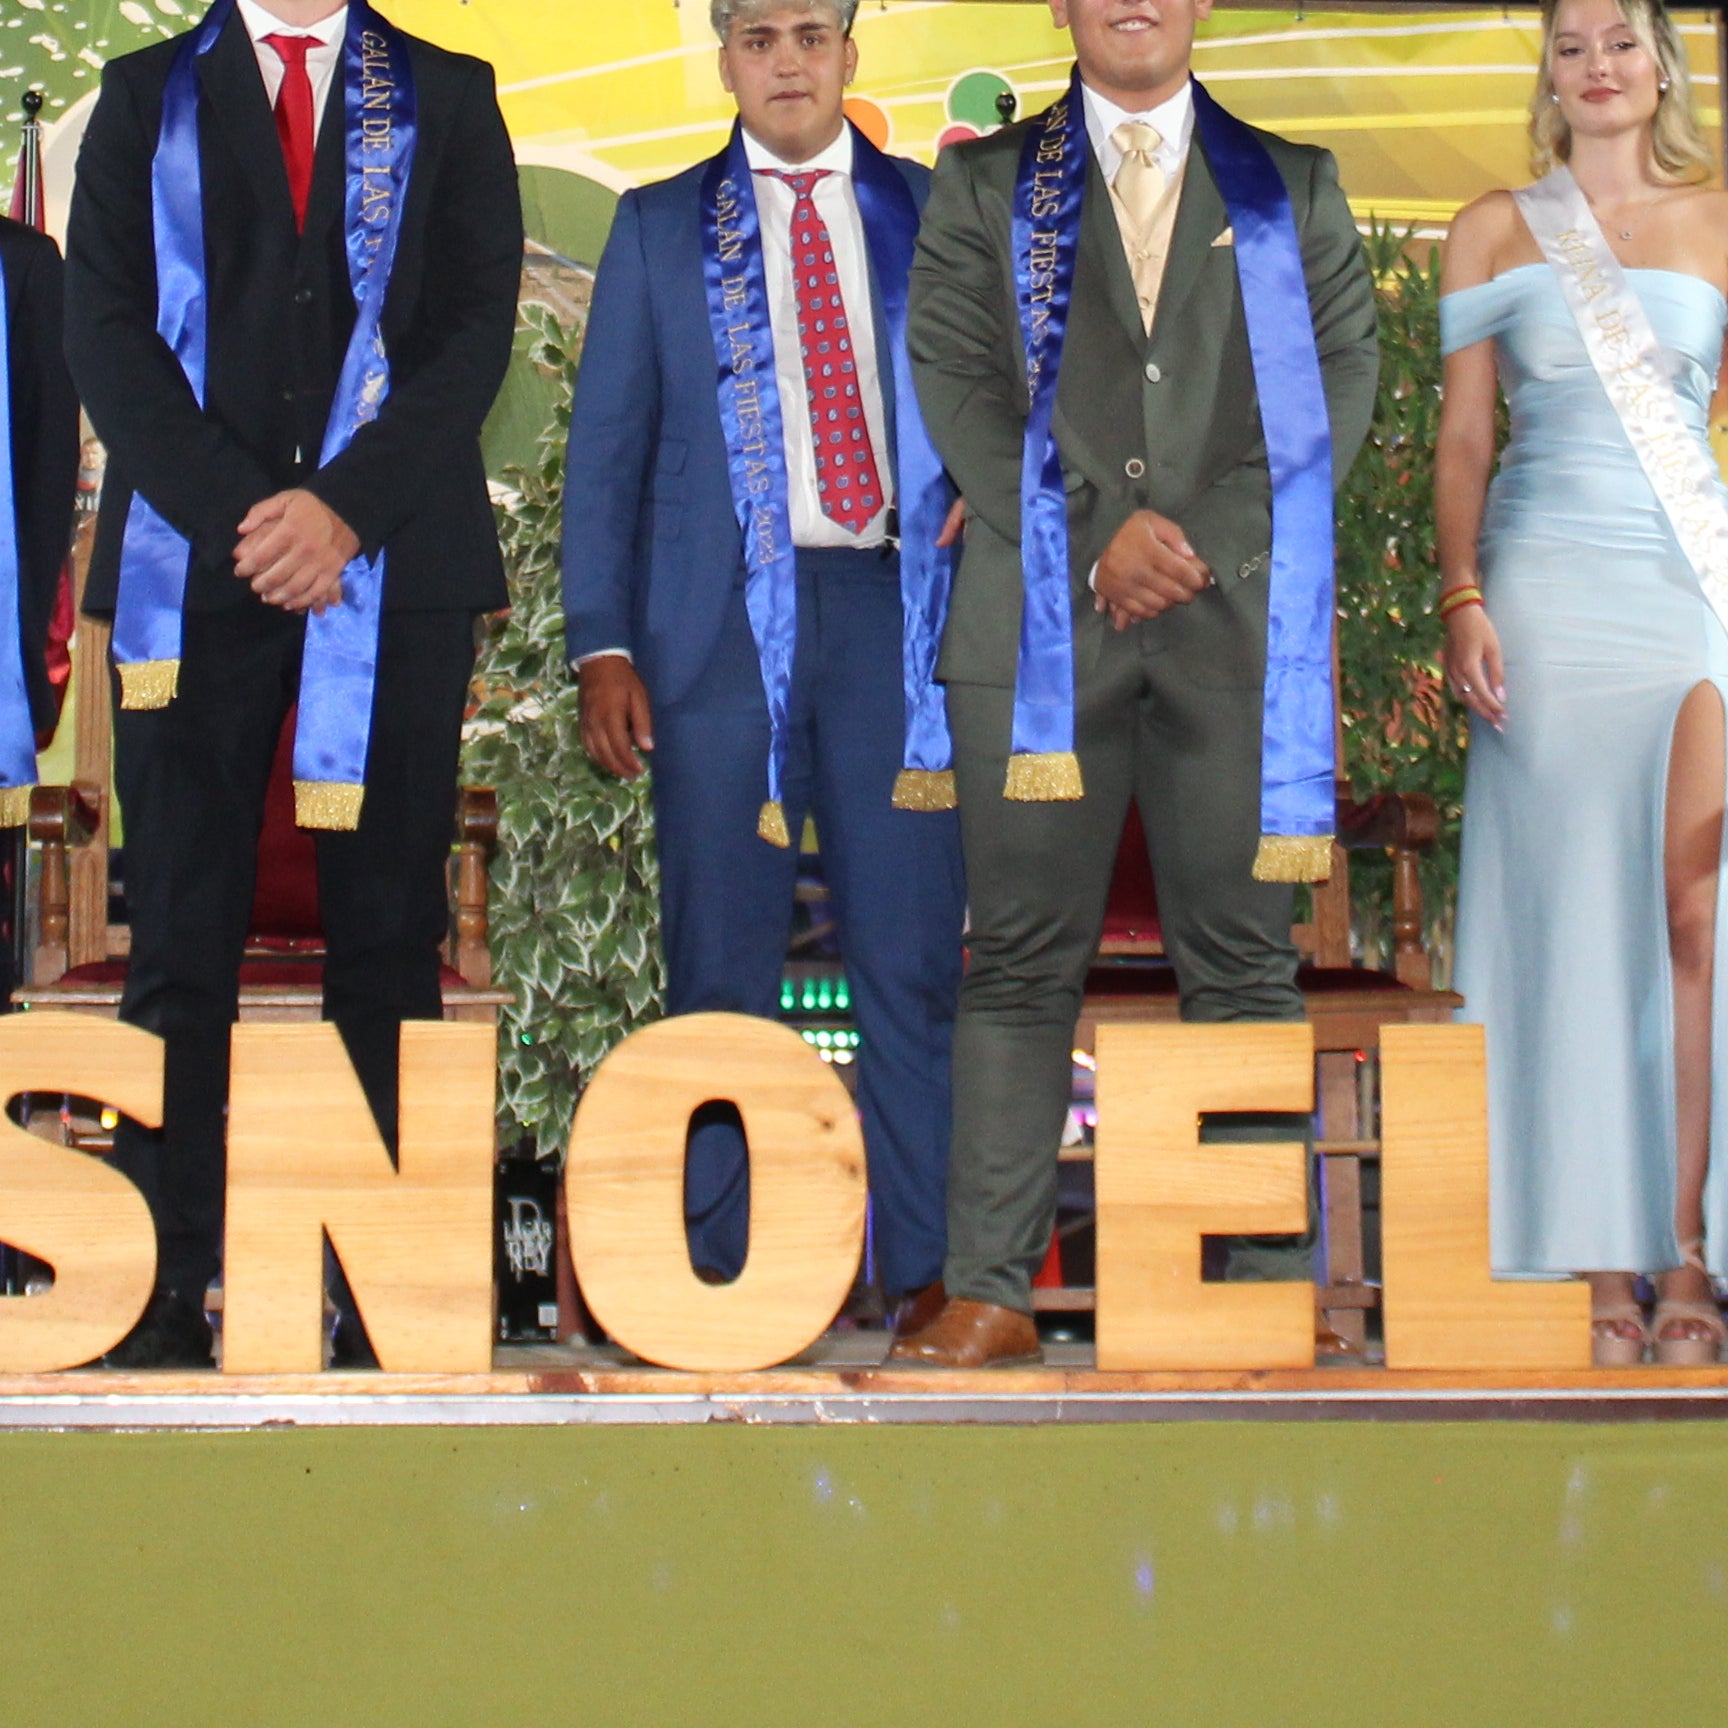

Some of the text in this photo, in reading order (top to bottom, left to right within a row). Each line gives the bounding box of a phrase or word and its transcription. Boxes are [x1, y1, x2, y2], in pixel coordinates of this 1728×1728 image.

[362, 118, 392, 153] DE
[1036, 134, 1065, 163] DE
[362, 165, 390, 223] LAS
[1031, 170, 1063, 217] LAS
[716, 179, 775, 564] GALÁN DE LAS FIESTAS 2023
[1595, 308, 1631, 351] DE
[1616, 359, 1656, 419] LAS
[1094, 1023, 1592, 1371] EL
